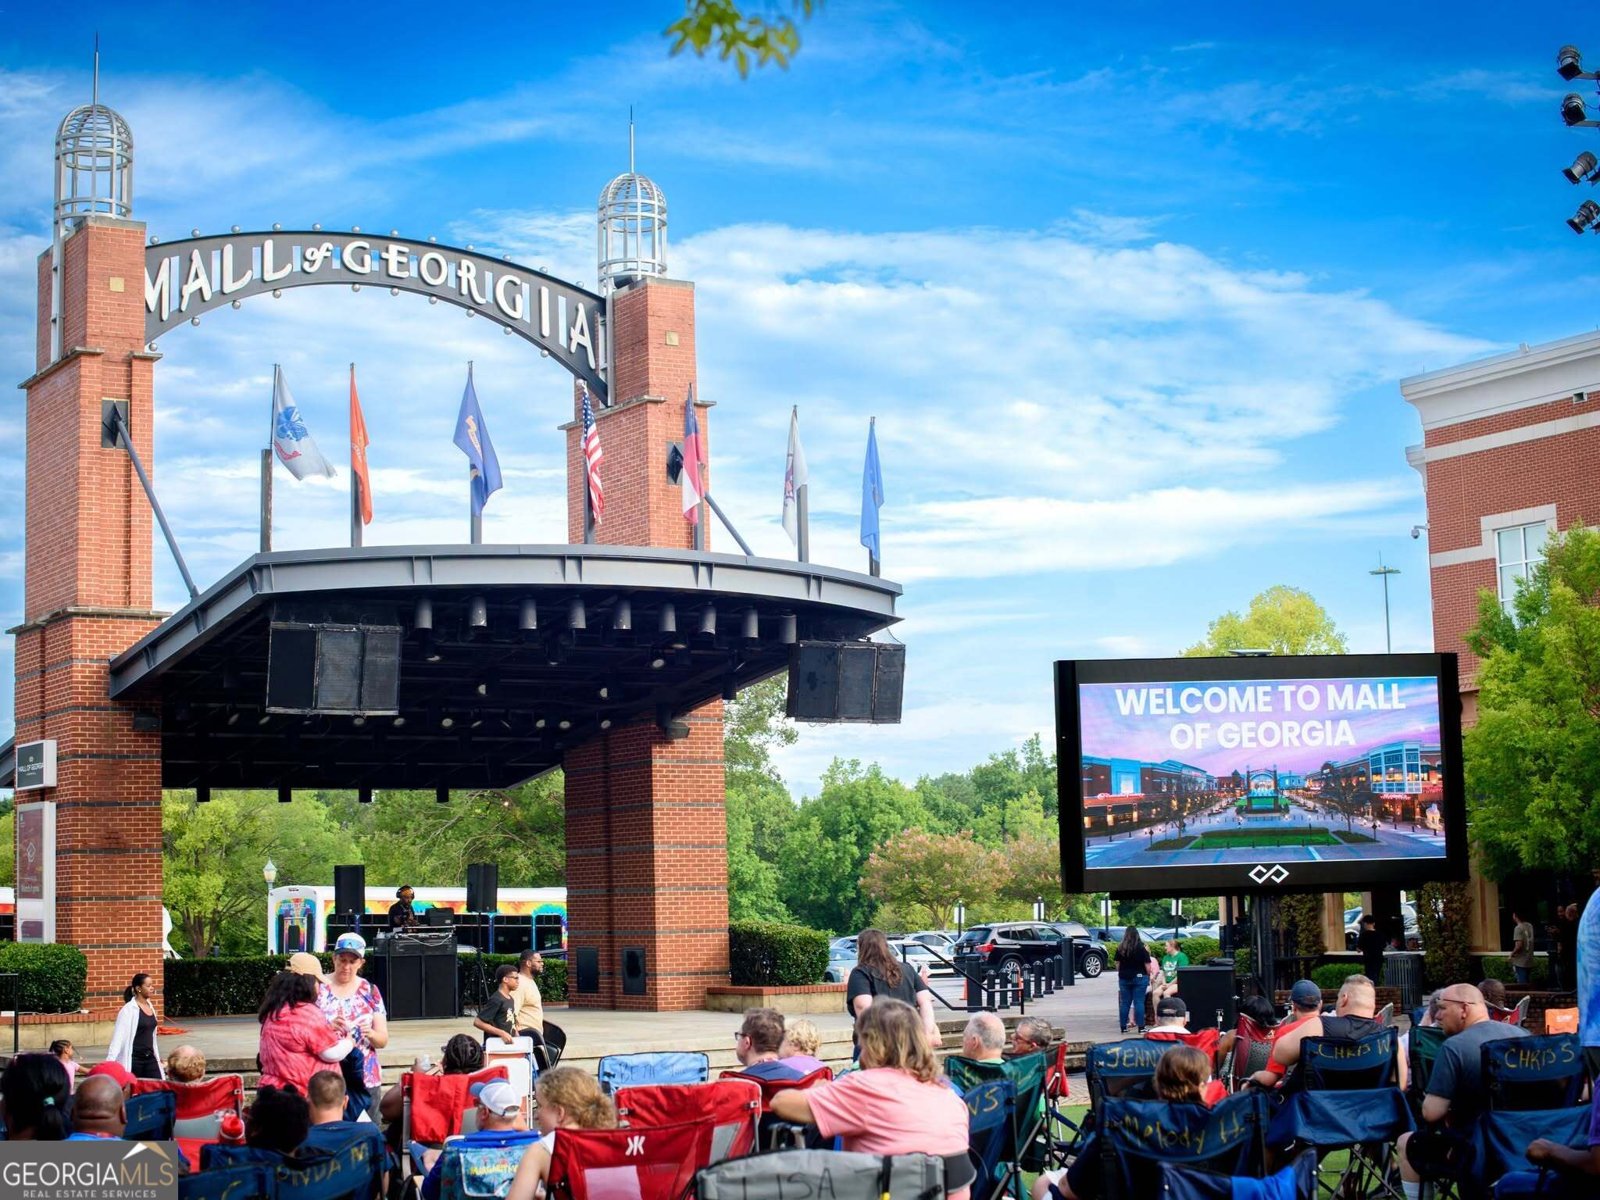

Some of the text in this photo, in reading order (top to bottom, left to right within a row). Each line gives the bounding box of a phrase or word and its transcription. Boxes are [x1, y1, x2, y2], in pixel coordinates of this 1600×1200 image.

[144, 239, 596, 370] MALL of GEORGIA
[1115, 683, 1406, 716] WELCOME TO MALL
[1170, 719, 1357, 751] OF GEORGIA
[1504, 1042, 1575, 1071] CHRIS S
